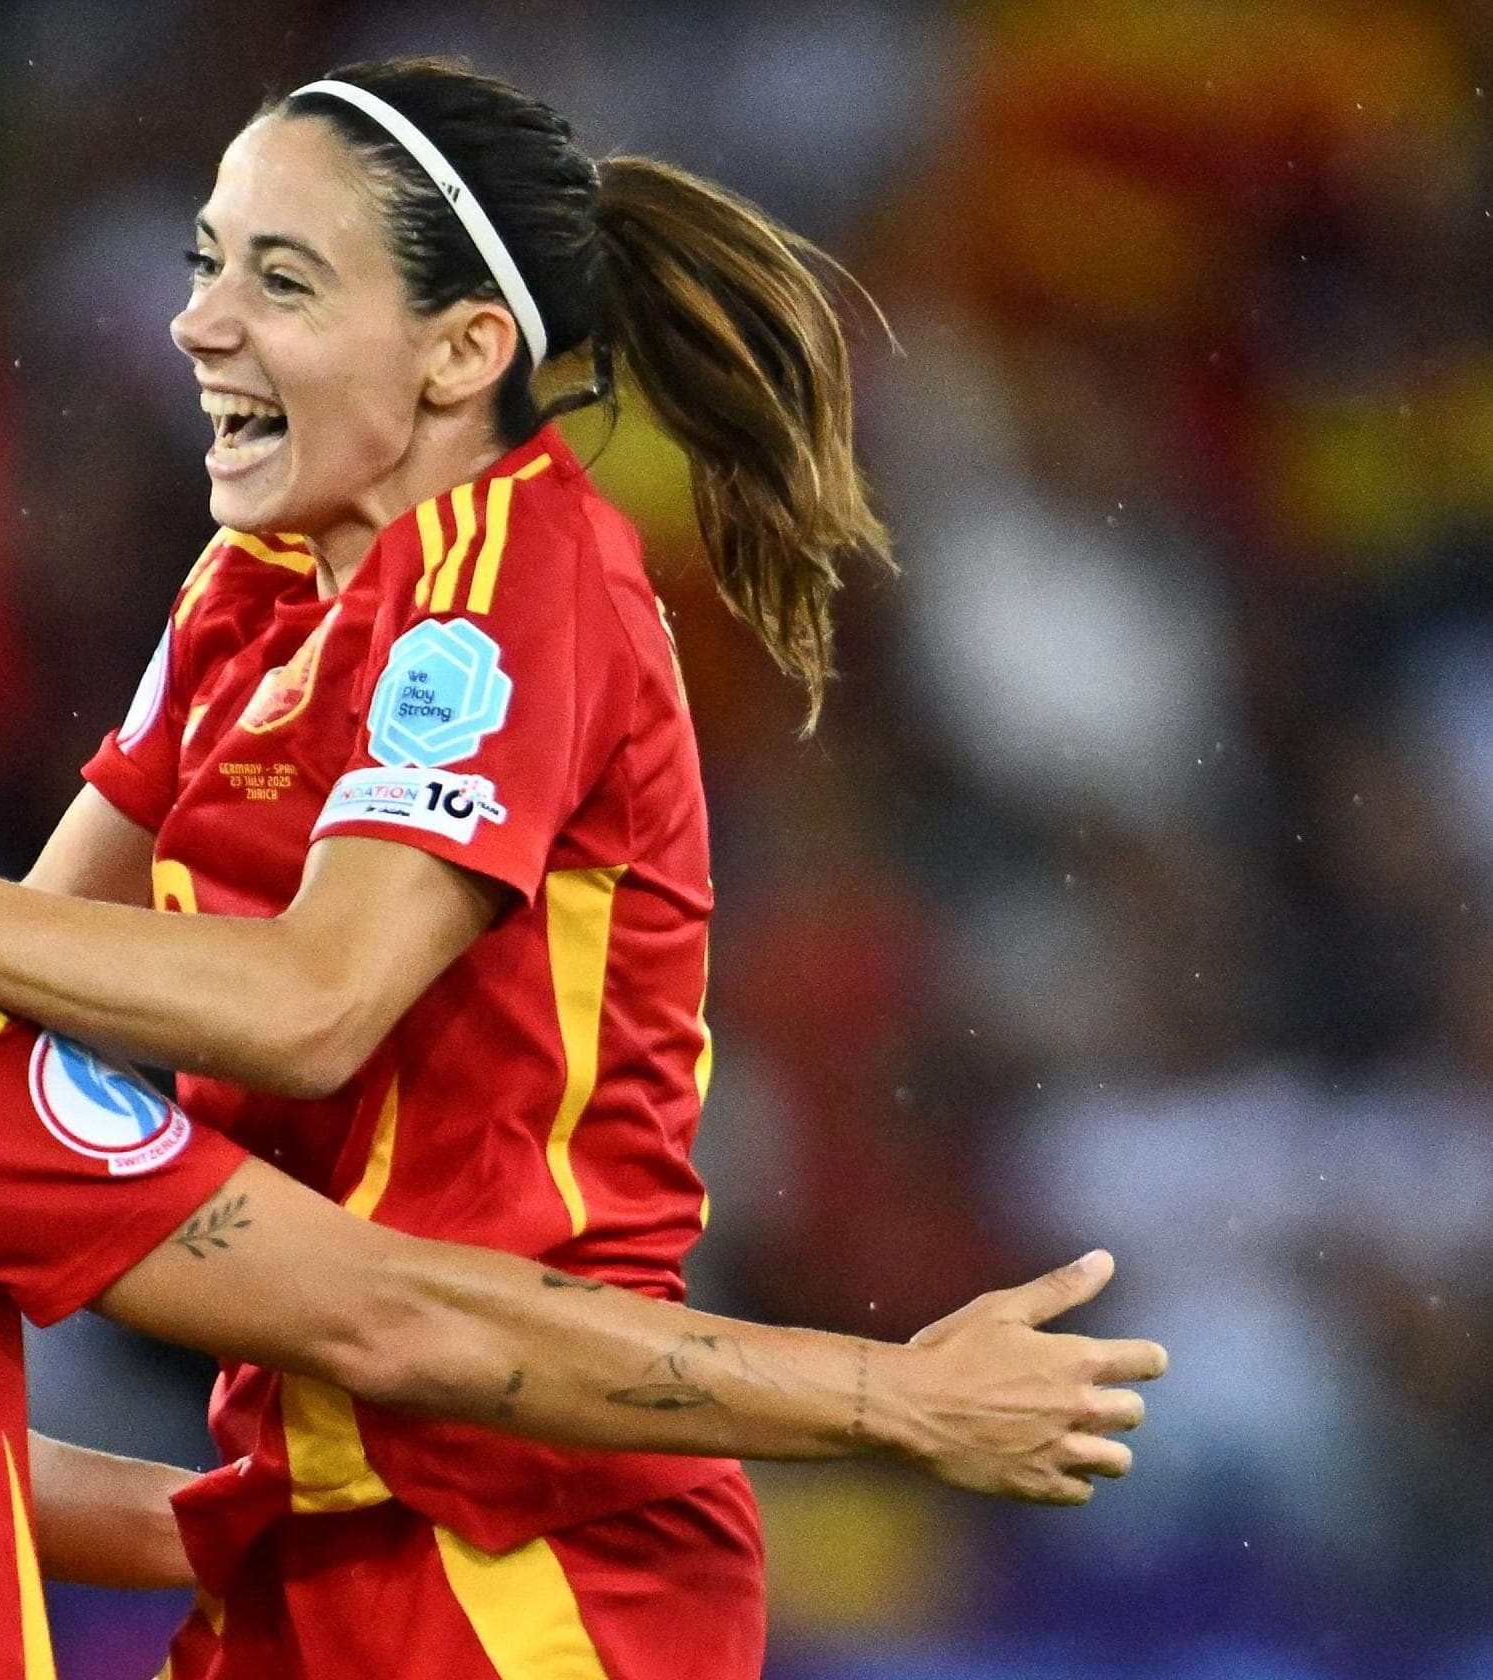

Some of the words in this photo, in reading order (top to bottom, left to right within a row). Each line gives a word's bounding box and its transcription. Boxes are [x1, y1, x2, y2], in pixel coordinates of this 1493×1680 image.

[402, 686, 435, 704] Play
[398, 702, 452, 722] Strong
[244, 775, 265, 787] JULY
[267, 775, 291, 787] 2025
[425, 781, 474, 819] 10
